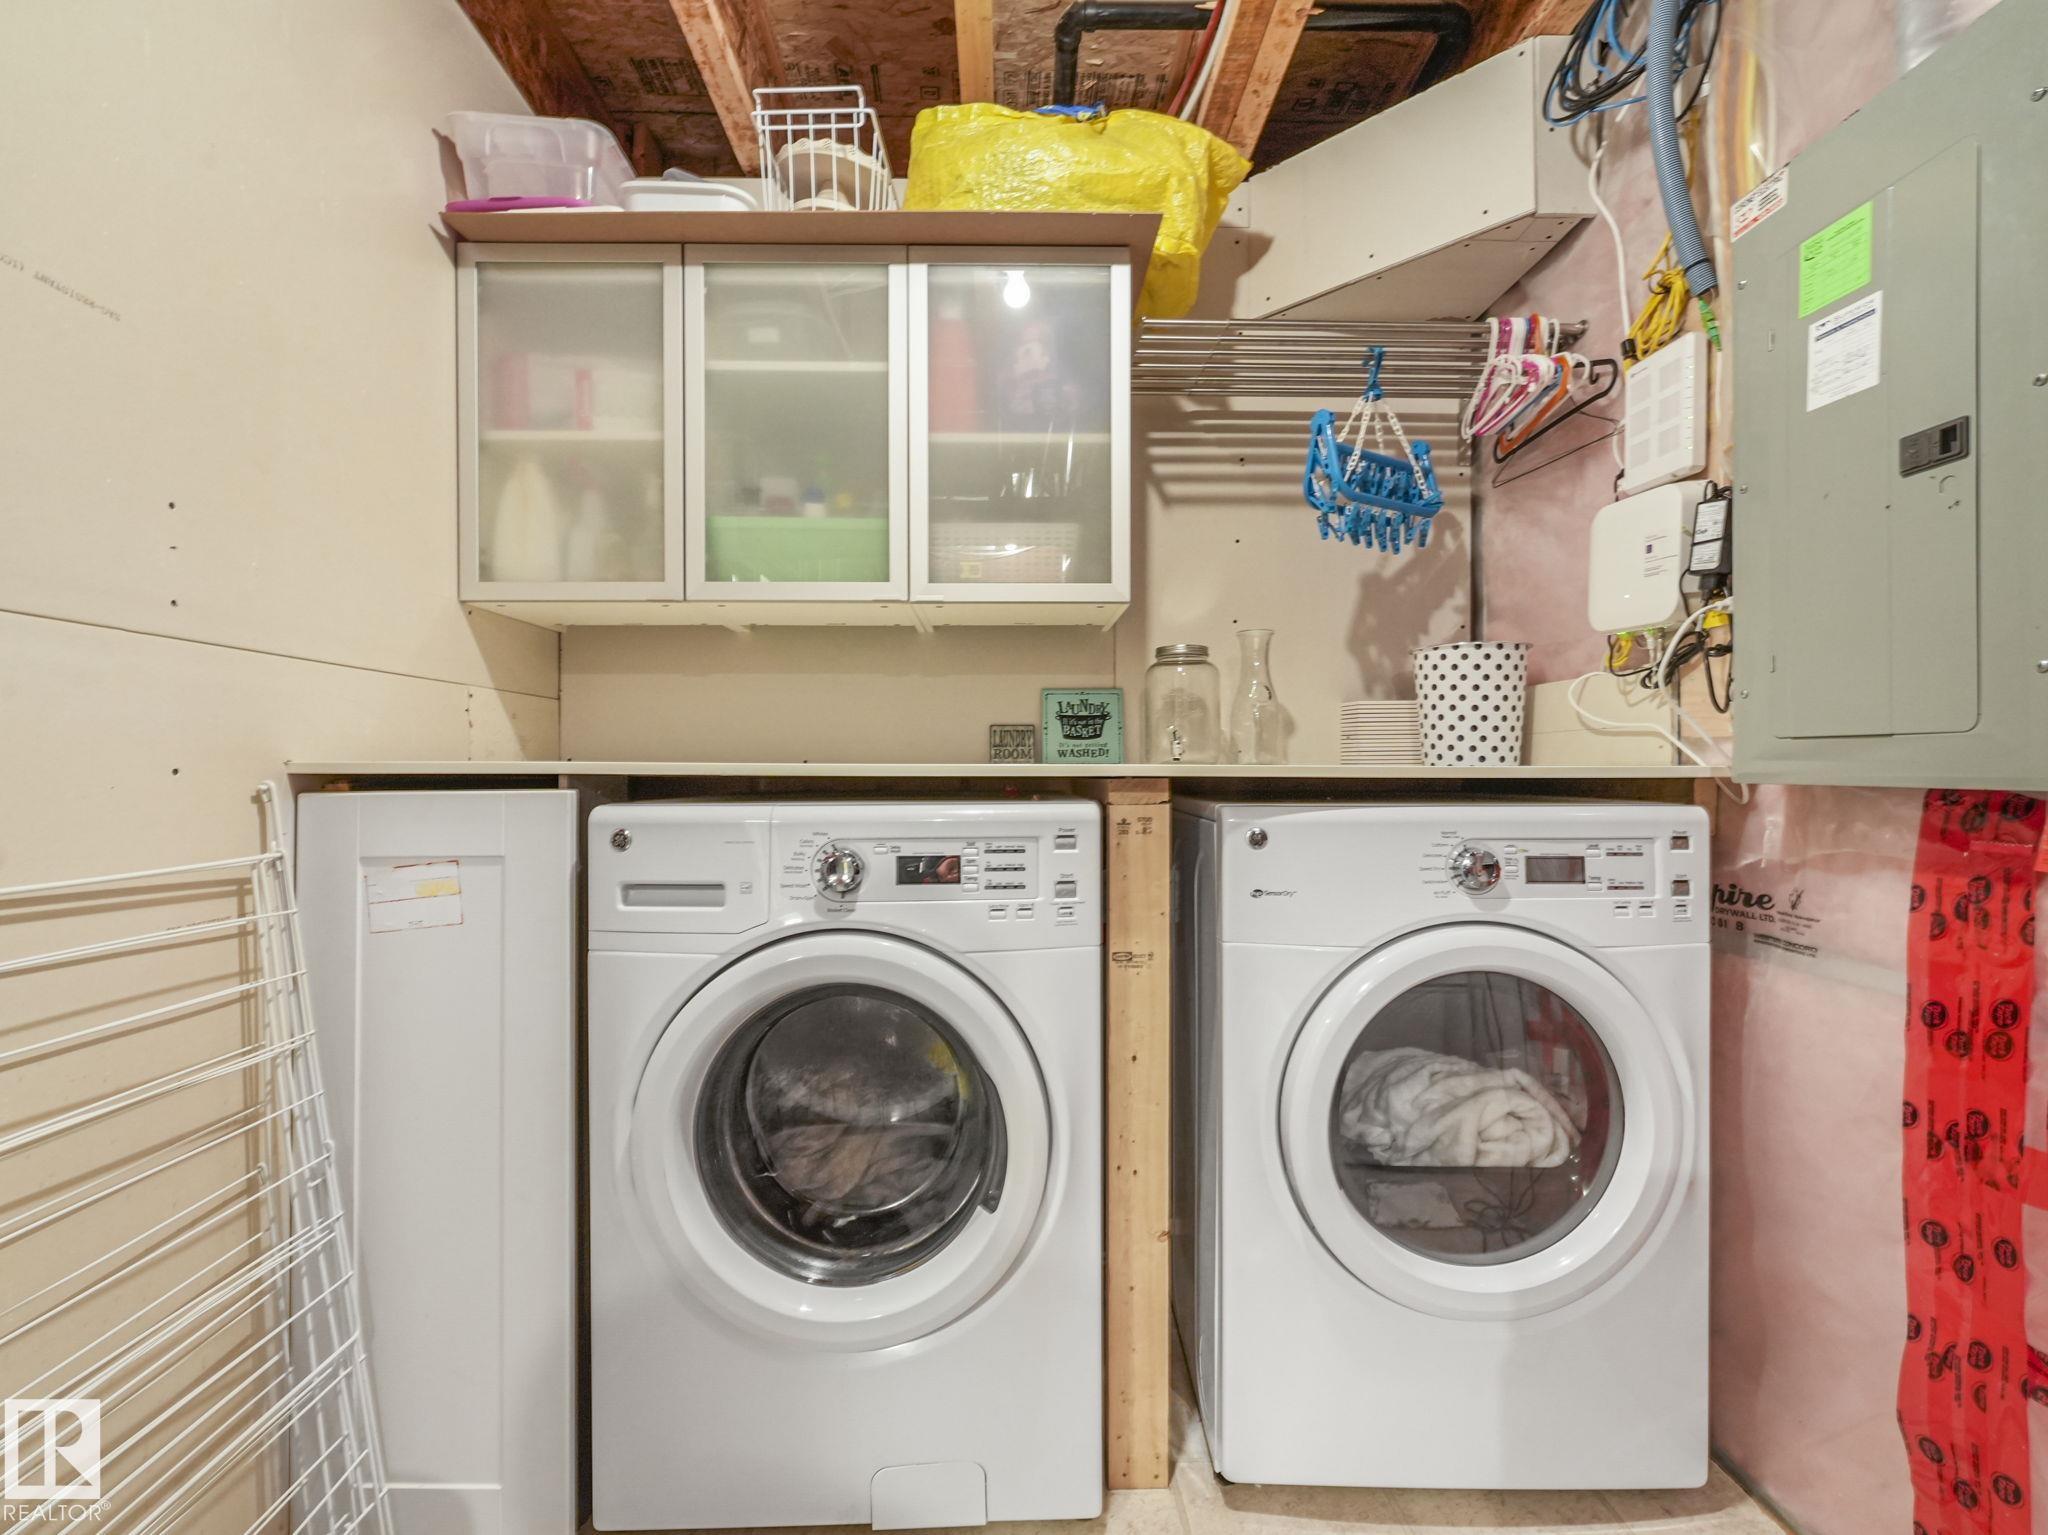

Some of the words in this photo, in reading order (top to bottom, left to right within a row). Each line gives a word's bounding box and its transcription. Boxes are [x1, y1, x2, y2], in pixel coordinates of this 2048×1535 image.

[1056, 698, 1110, 716] LAUNDRY
[1063, 725, 1103, 738] BASKET
[992, 729, 1033, 748] LAUNDRY
[993, 748, 1033, 760] ROOM
[1057, 748, 1110, 758] WASHED!
